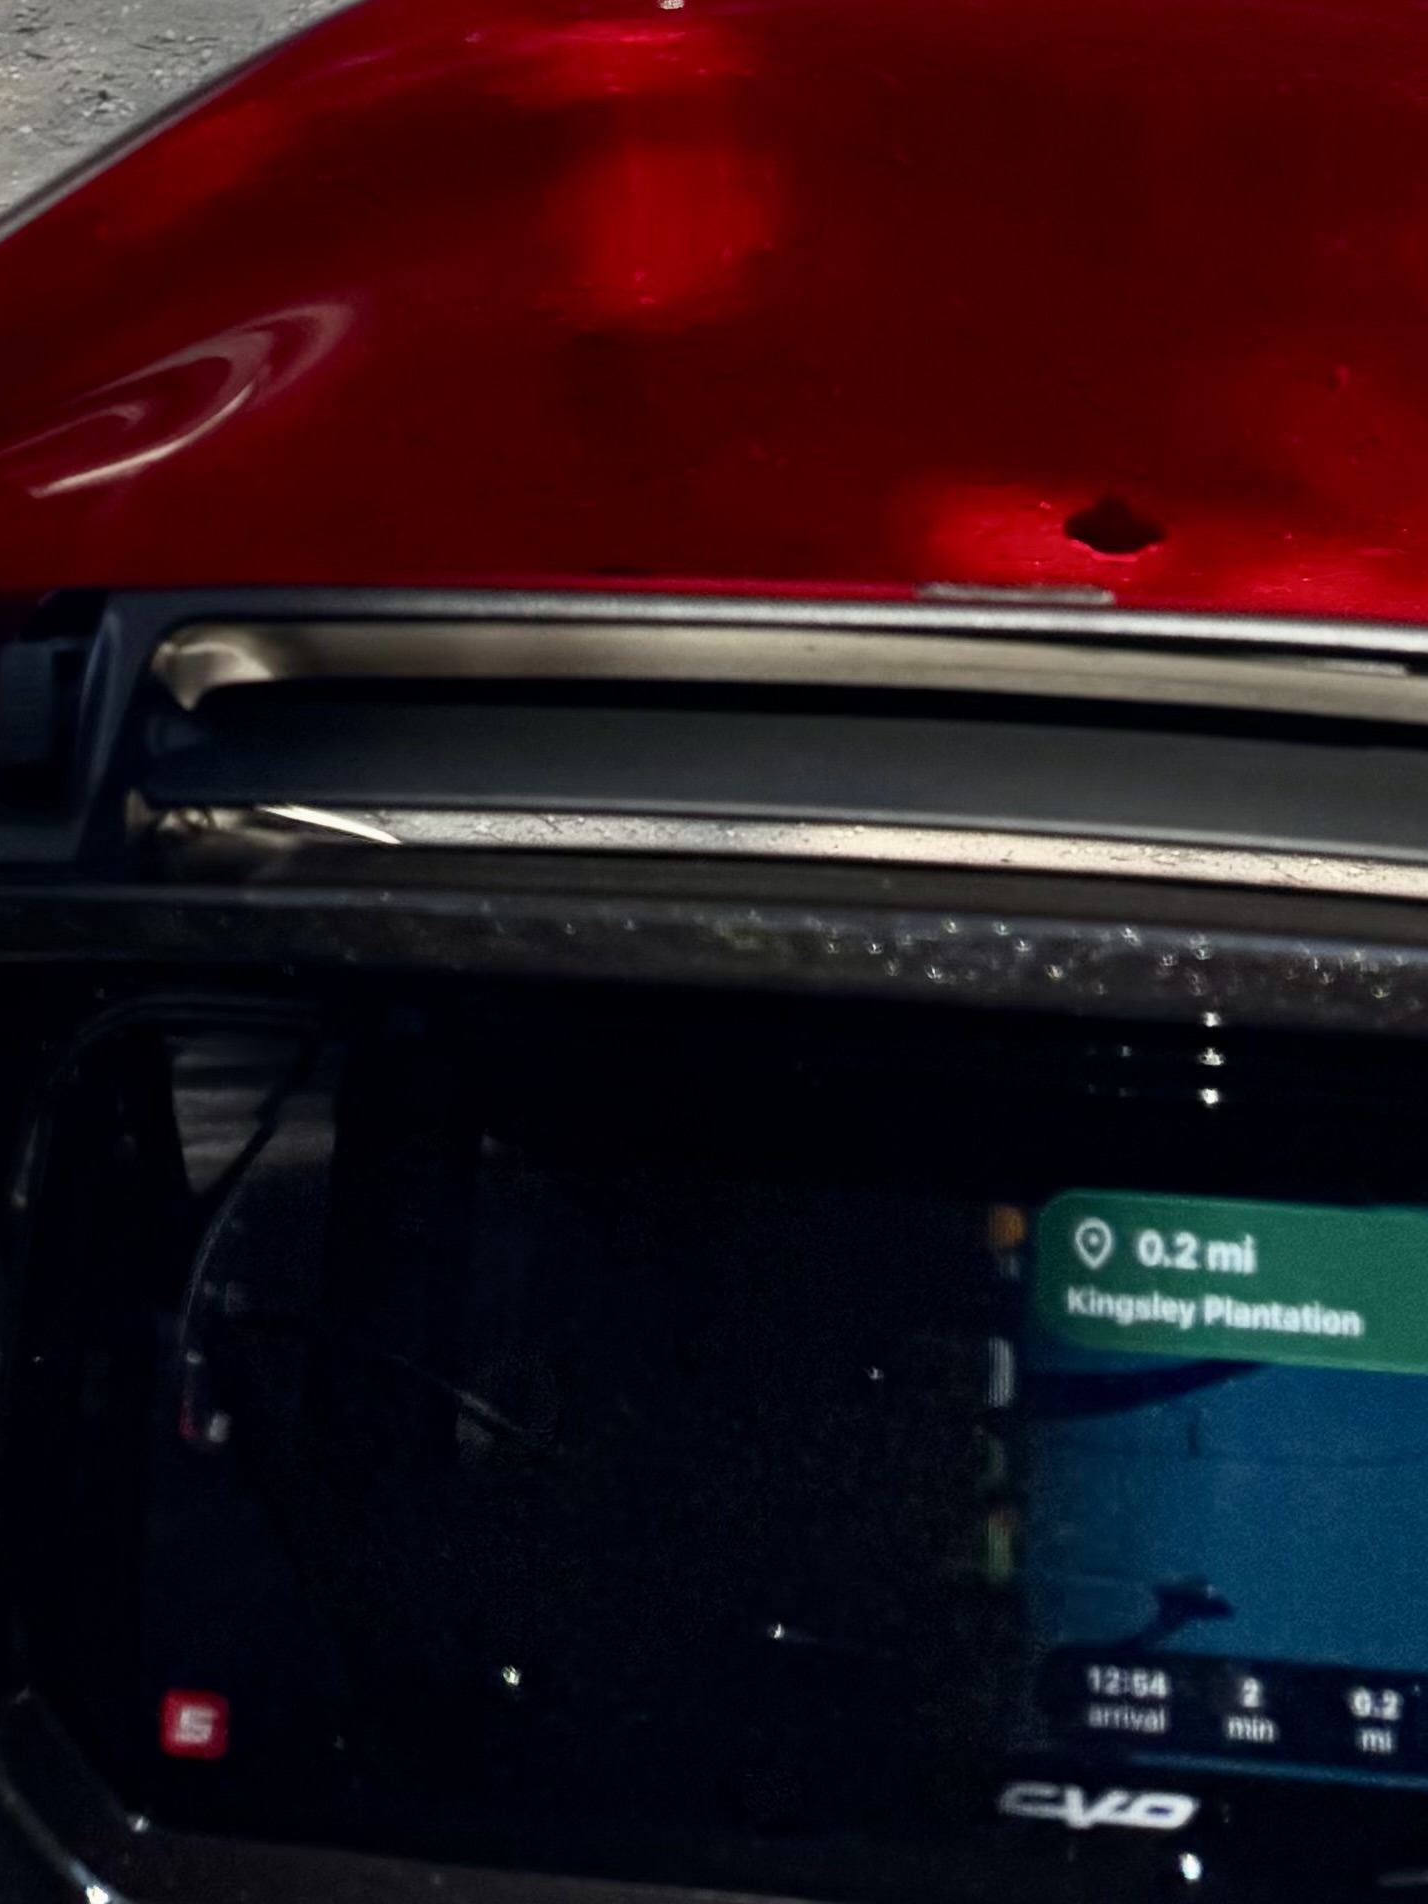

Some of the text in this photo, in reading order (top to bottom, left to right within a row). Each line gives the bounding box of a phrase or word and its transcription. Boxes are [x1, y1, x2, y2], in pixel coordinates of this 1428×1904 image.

[1137, 1229, 1258, 1276] 0.2 mi
[1067, 1284, 1364, 1340] Kingsley Plantation
[1239, 1677, 1264, 1709] 2
[1087, 1704, 1395, 1755] arrival min mi
[997, 1780, 1202, 1830] CVO
